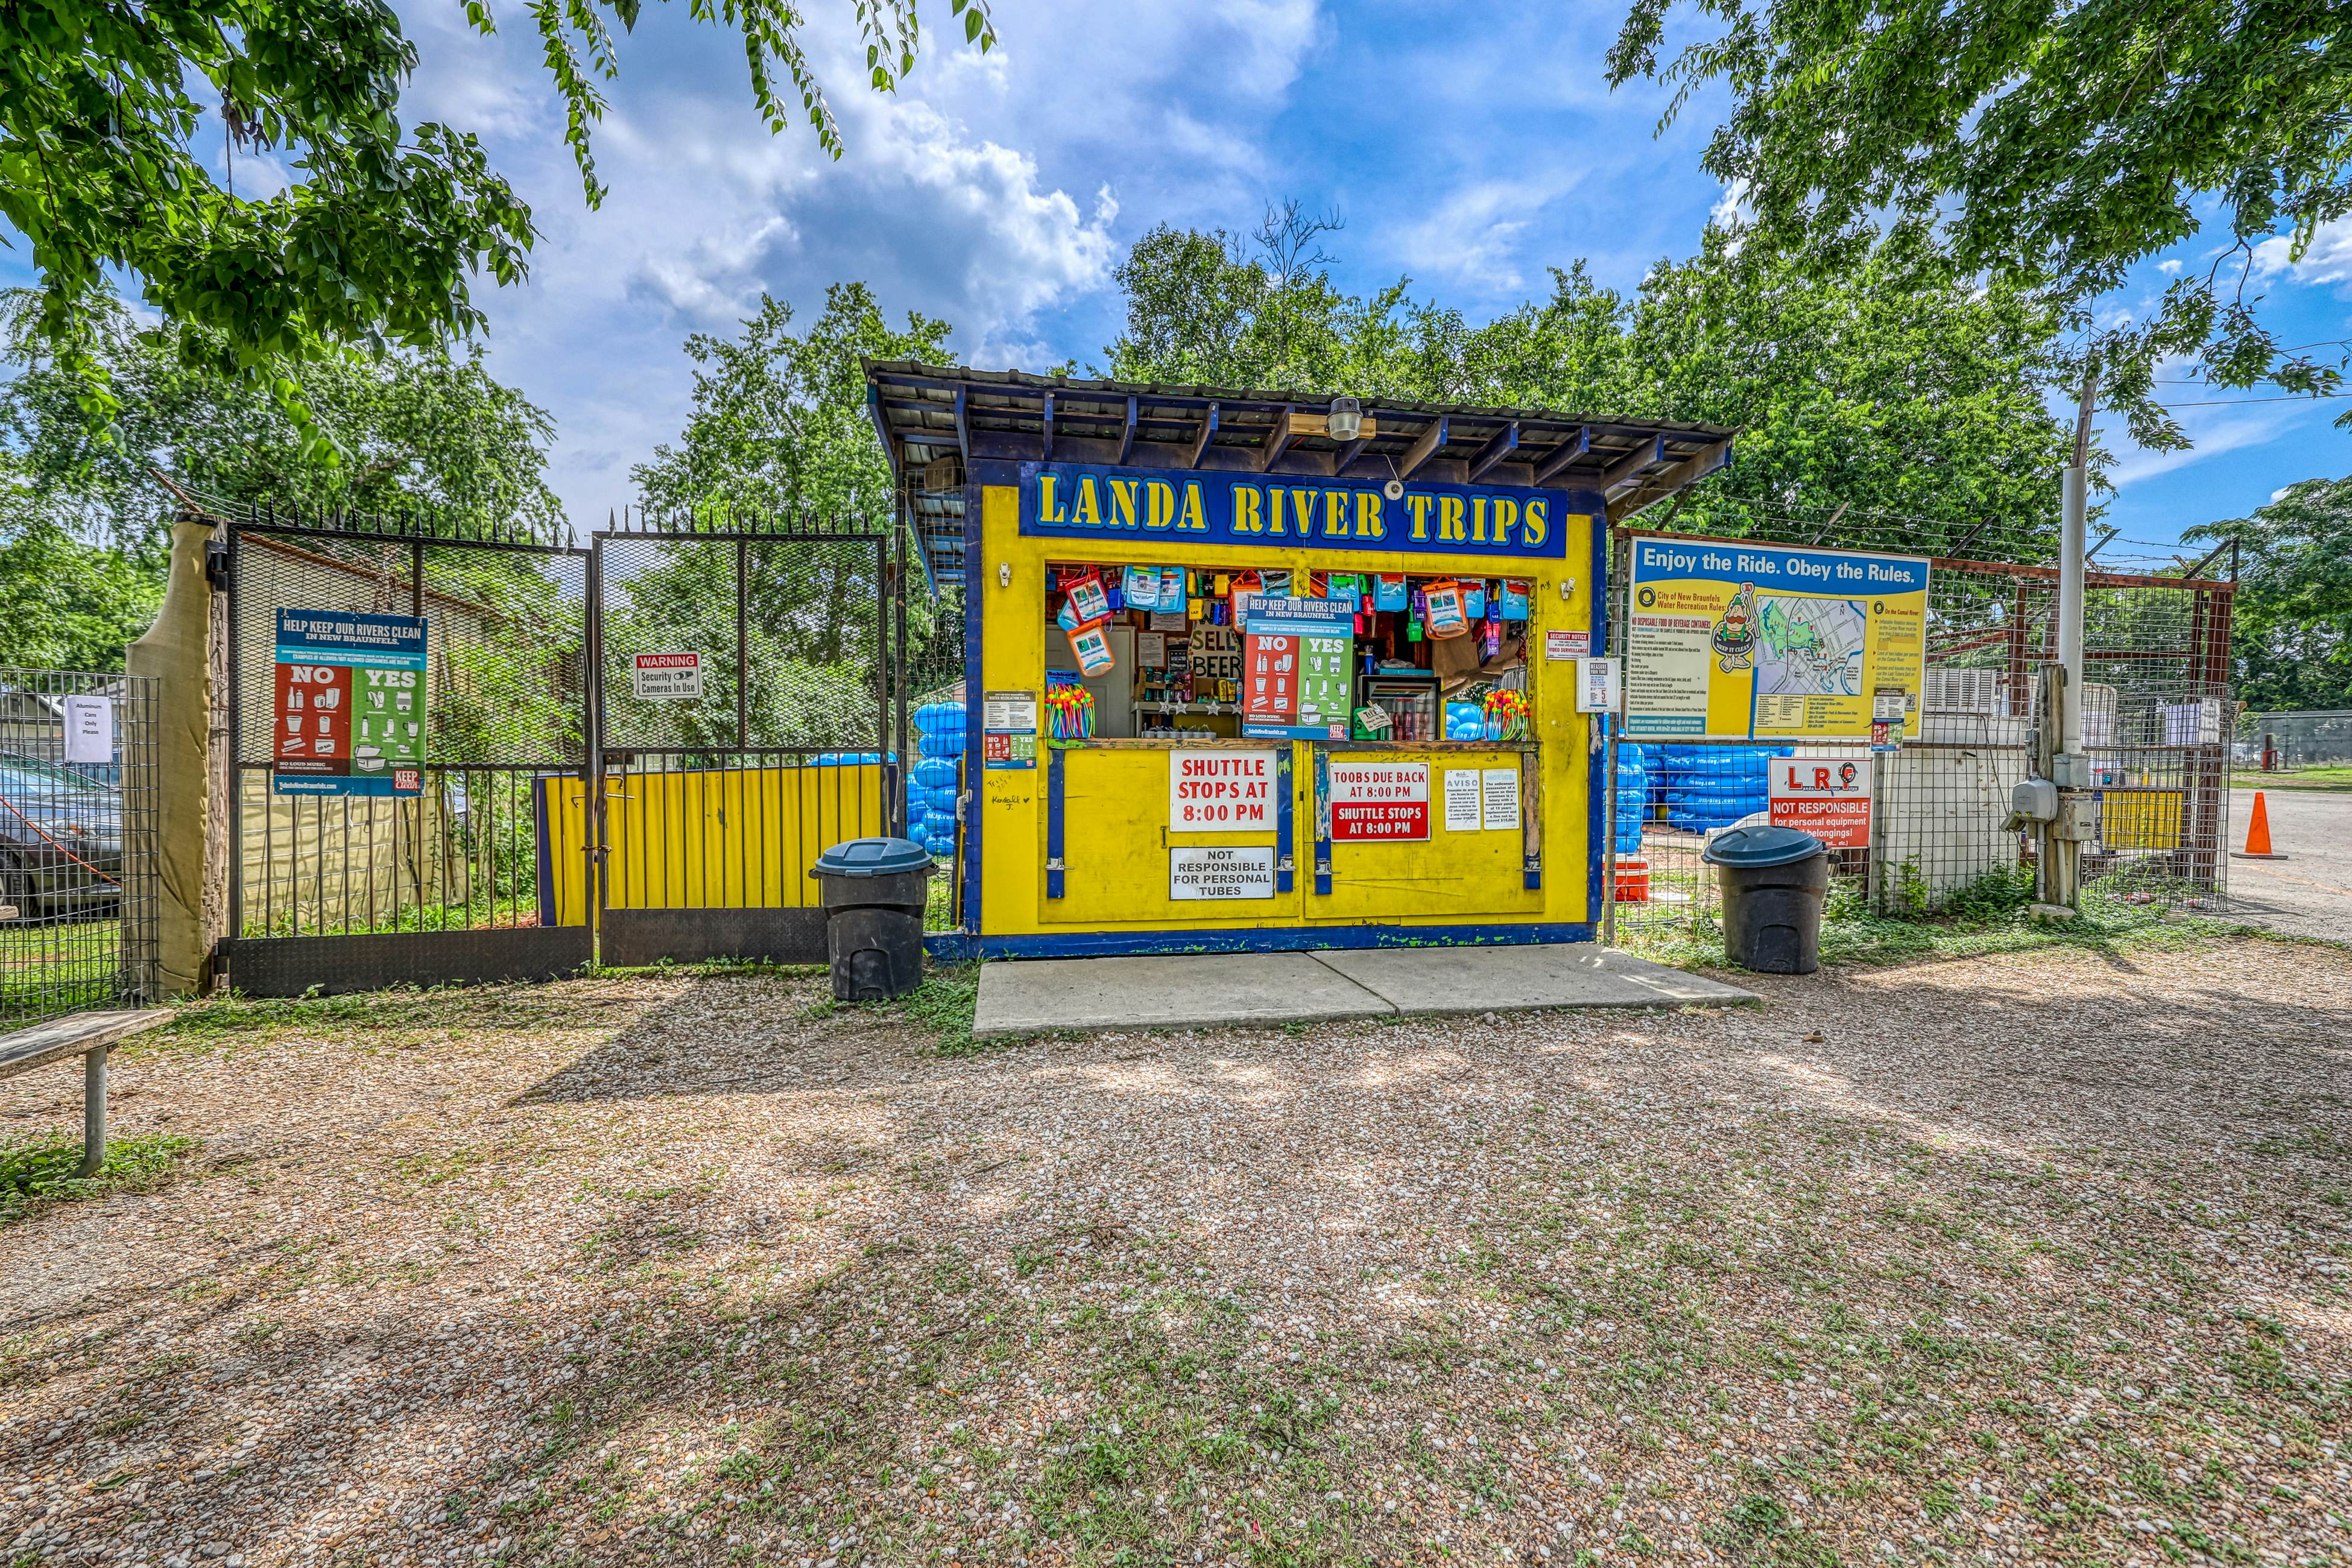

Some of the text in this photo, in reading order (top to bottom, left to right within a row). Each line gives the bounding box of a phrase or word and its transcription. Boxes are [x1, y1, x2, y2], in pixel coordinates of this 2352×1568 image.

[1038, 475, 1547, 546] LANDA RIVER TRIPS
[1643, 548, 1915, 583] Enjoy the Ride. Obey the Rules.
[1657, 592, 1669, 601] City
[1678, 593, 1692, 601] New
[1693, 593, 1720, 602] Braunfels
[1250, 598, 1352, 614] HELP KEEP OUR RIVERS CLEAN
[1657, 601, 1675, 609] Water
[1677, 602, 1708, 611] Recreation
[283, 619, 421, 639] HELP KEEP OUR RIVERS CLEAN
[1631, 617, 1637, 625] NO
[1637, 618, 1658, 627] DISPOSABLE
[1674, 619, 1690, 628] BEVERAGE
[1691, 620, 1711, 629] CONTAINERS
[343, 636, 400, 645] BRAUNFELS.
[1192, 630, 1236, 651] SELL
[1257, 636, 1344, 654] NO YES
[1716, 643, 1728, 652] KEEP
[640, 656, 695, 667] WARNING
[1193, 656, 1242, 678] BEER
[291, 666, 416, 688] NO YES
[641, 671, 672, 683] Security
[642, 682, 695, 693] Cameras In Use
[1329, 724, 1344, 733] KEEP
[1181, 759, 1265, 777] SHUTTLE
[395, 770, 418, 782] KEEP
[1334, 771, 1425, 783] TOOBS DUE BACK
[395, 780, 419, 789] Clean
[1178, 782, 1268, 799] STOPS AT
[1350, 786, 1411, 797] AT 8:00 PM
[991, 795, 1020, 804] Kendall
[1183, 804, 1263, 821] 8:00 PM
[1338, 807, 1421, 820] SHUTTLE STOPS
[1773, 802, 1868, 814] NOT RESPONSIBLE
[1349, 821, 1411, 834] AT 8:00 PM
[1774, 817, 1867, 829] for personal equipment
[1807, 828, 1853, 839] belongings!
[1207, 850, 1234, 860] NOT
[1178, 862, 1266, 872] RESPONSIBLE
[1174, 874, 1270, 884] FOR PERSONAL
[1199, 887, 1241, 896] TUBES
